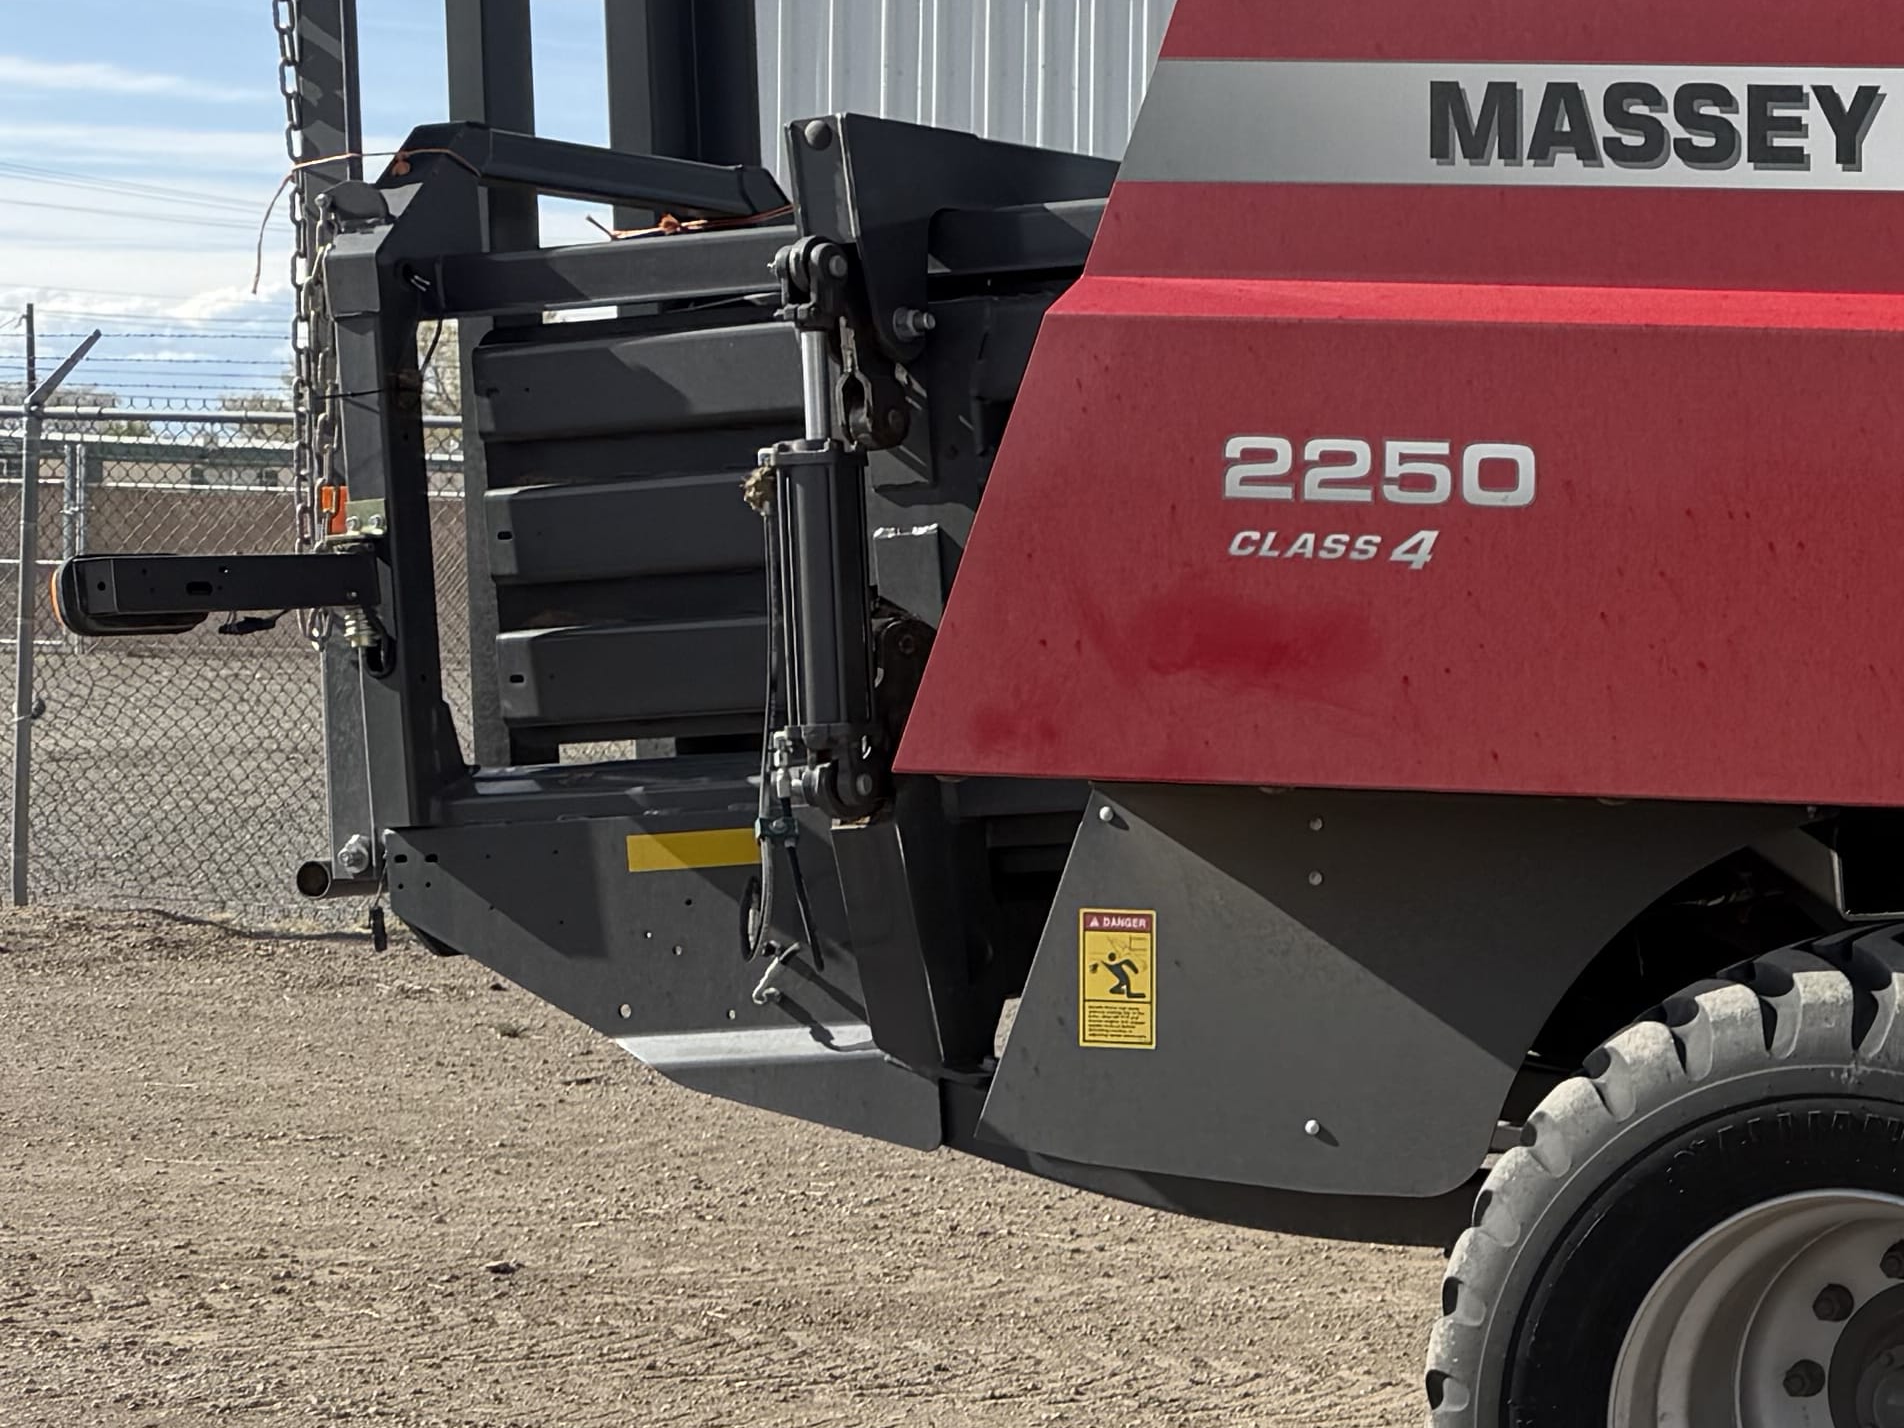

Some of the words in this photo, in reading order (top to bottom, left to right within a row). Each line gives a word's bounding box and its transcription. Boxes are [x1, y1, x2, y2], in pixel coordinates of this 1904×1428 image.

[1429, 80, 1884, 172] MASSEY
[1223, 434, 1538, 508] 2250
[1227, 530, 1382, 560] CLASS
[1389, 529, 1440, 570] 4
[1102, 916, 1147, 928] DANGER
